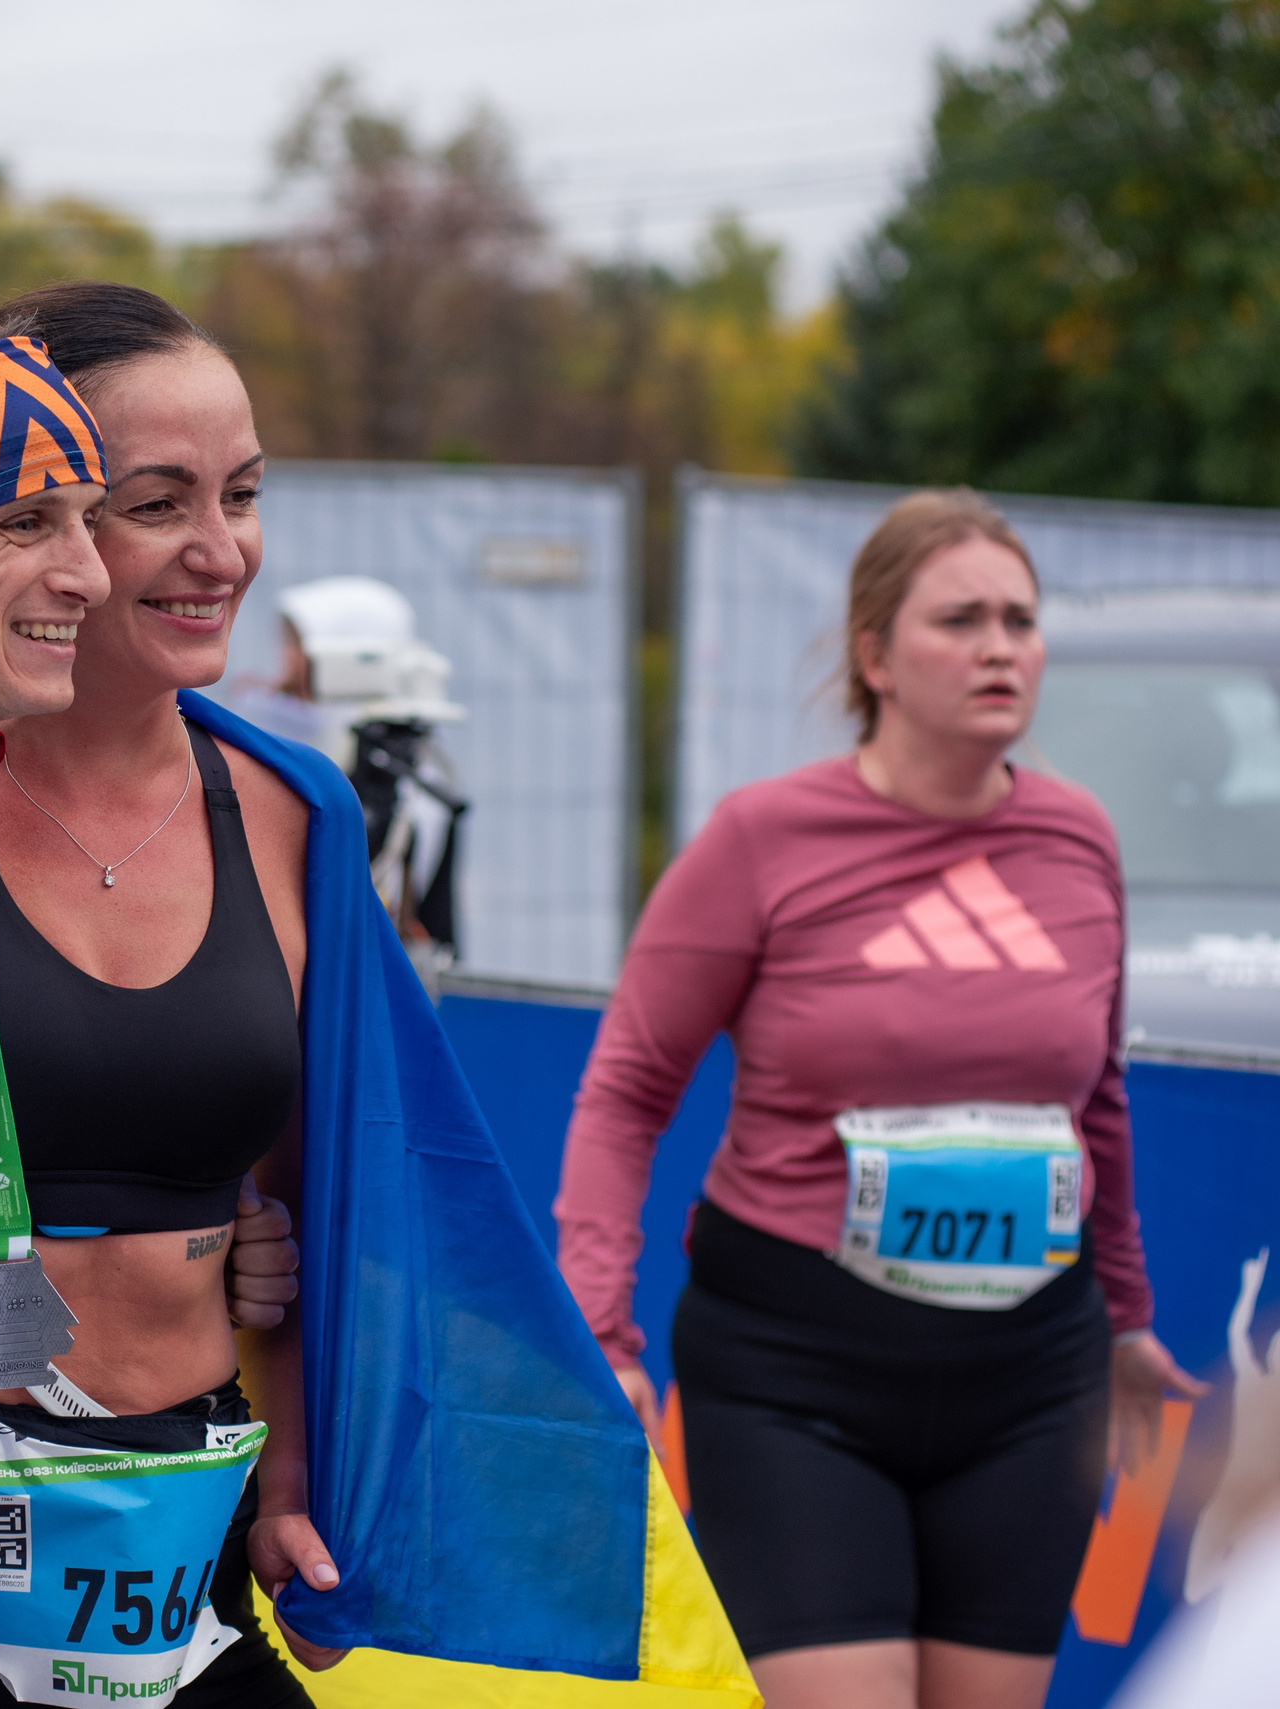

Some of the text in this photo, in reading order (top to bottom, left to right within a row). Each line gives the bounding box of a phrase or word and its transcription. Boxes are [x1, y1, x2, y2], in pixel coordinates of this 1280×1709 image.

[901, 1208, 1016, 1260] 7071
[7, 1361, 44, 1371] UKRAINE
[23, 1465, 53, 1477] 963:
[55, 1458, 132, 1475] КИЇВСЬКИЙ
[135, 1454, 193, 1469] МАРАФОН
[88, 1665, 183, 1701] ПриватБ
